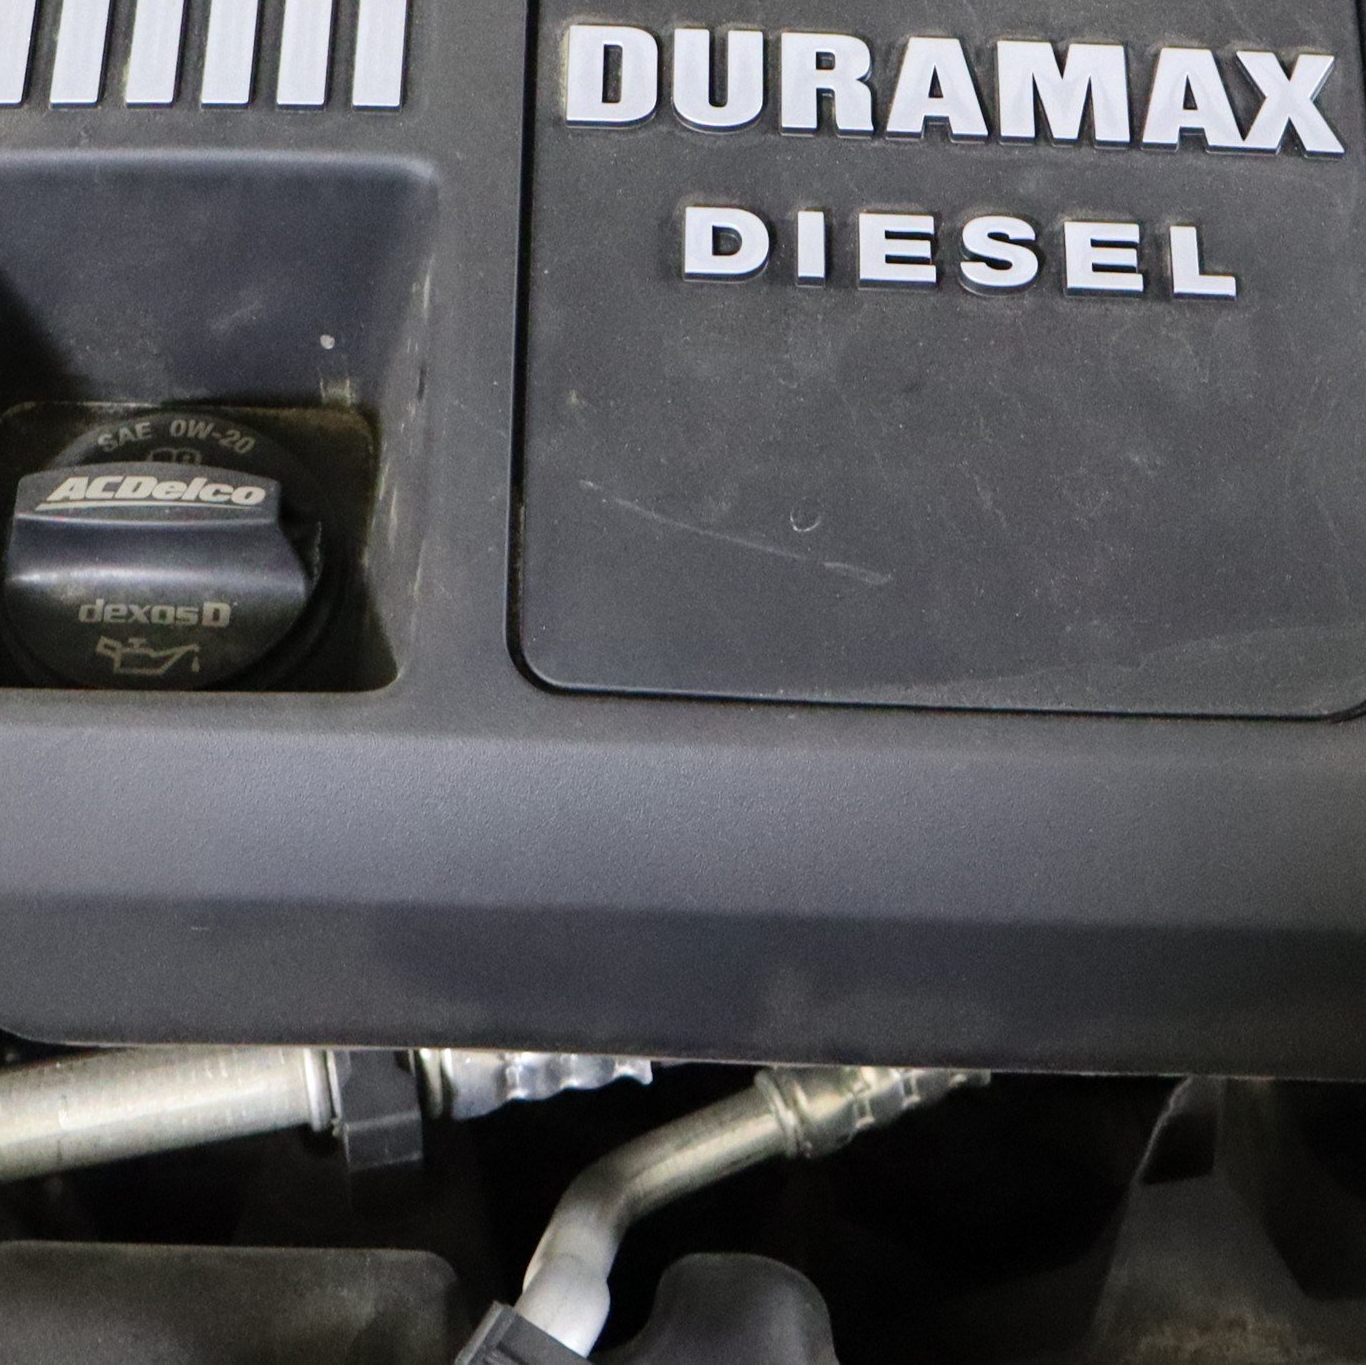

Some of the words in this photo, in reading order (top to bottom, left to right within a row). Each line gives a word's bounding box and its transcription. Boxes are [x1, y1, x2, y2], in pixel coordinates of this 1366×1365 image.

[564, 23, 1346, 159] DURAMAX
[682, 205, 1237, 300] DIESEL
[97, 421, 153, 453] SAE
[44, 475, 266, 507] ACDelco
